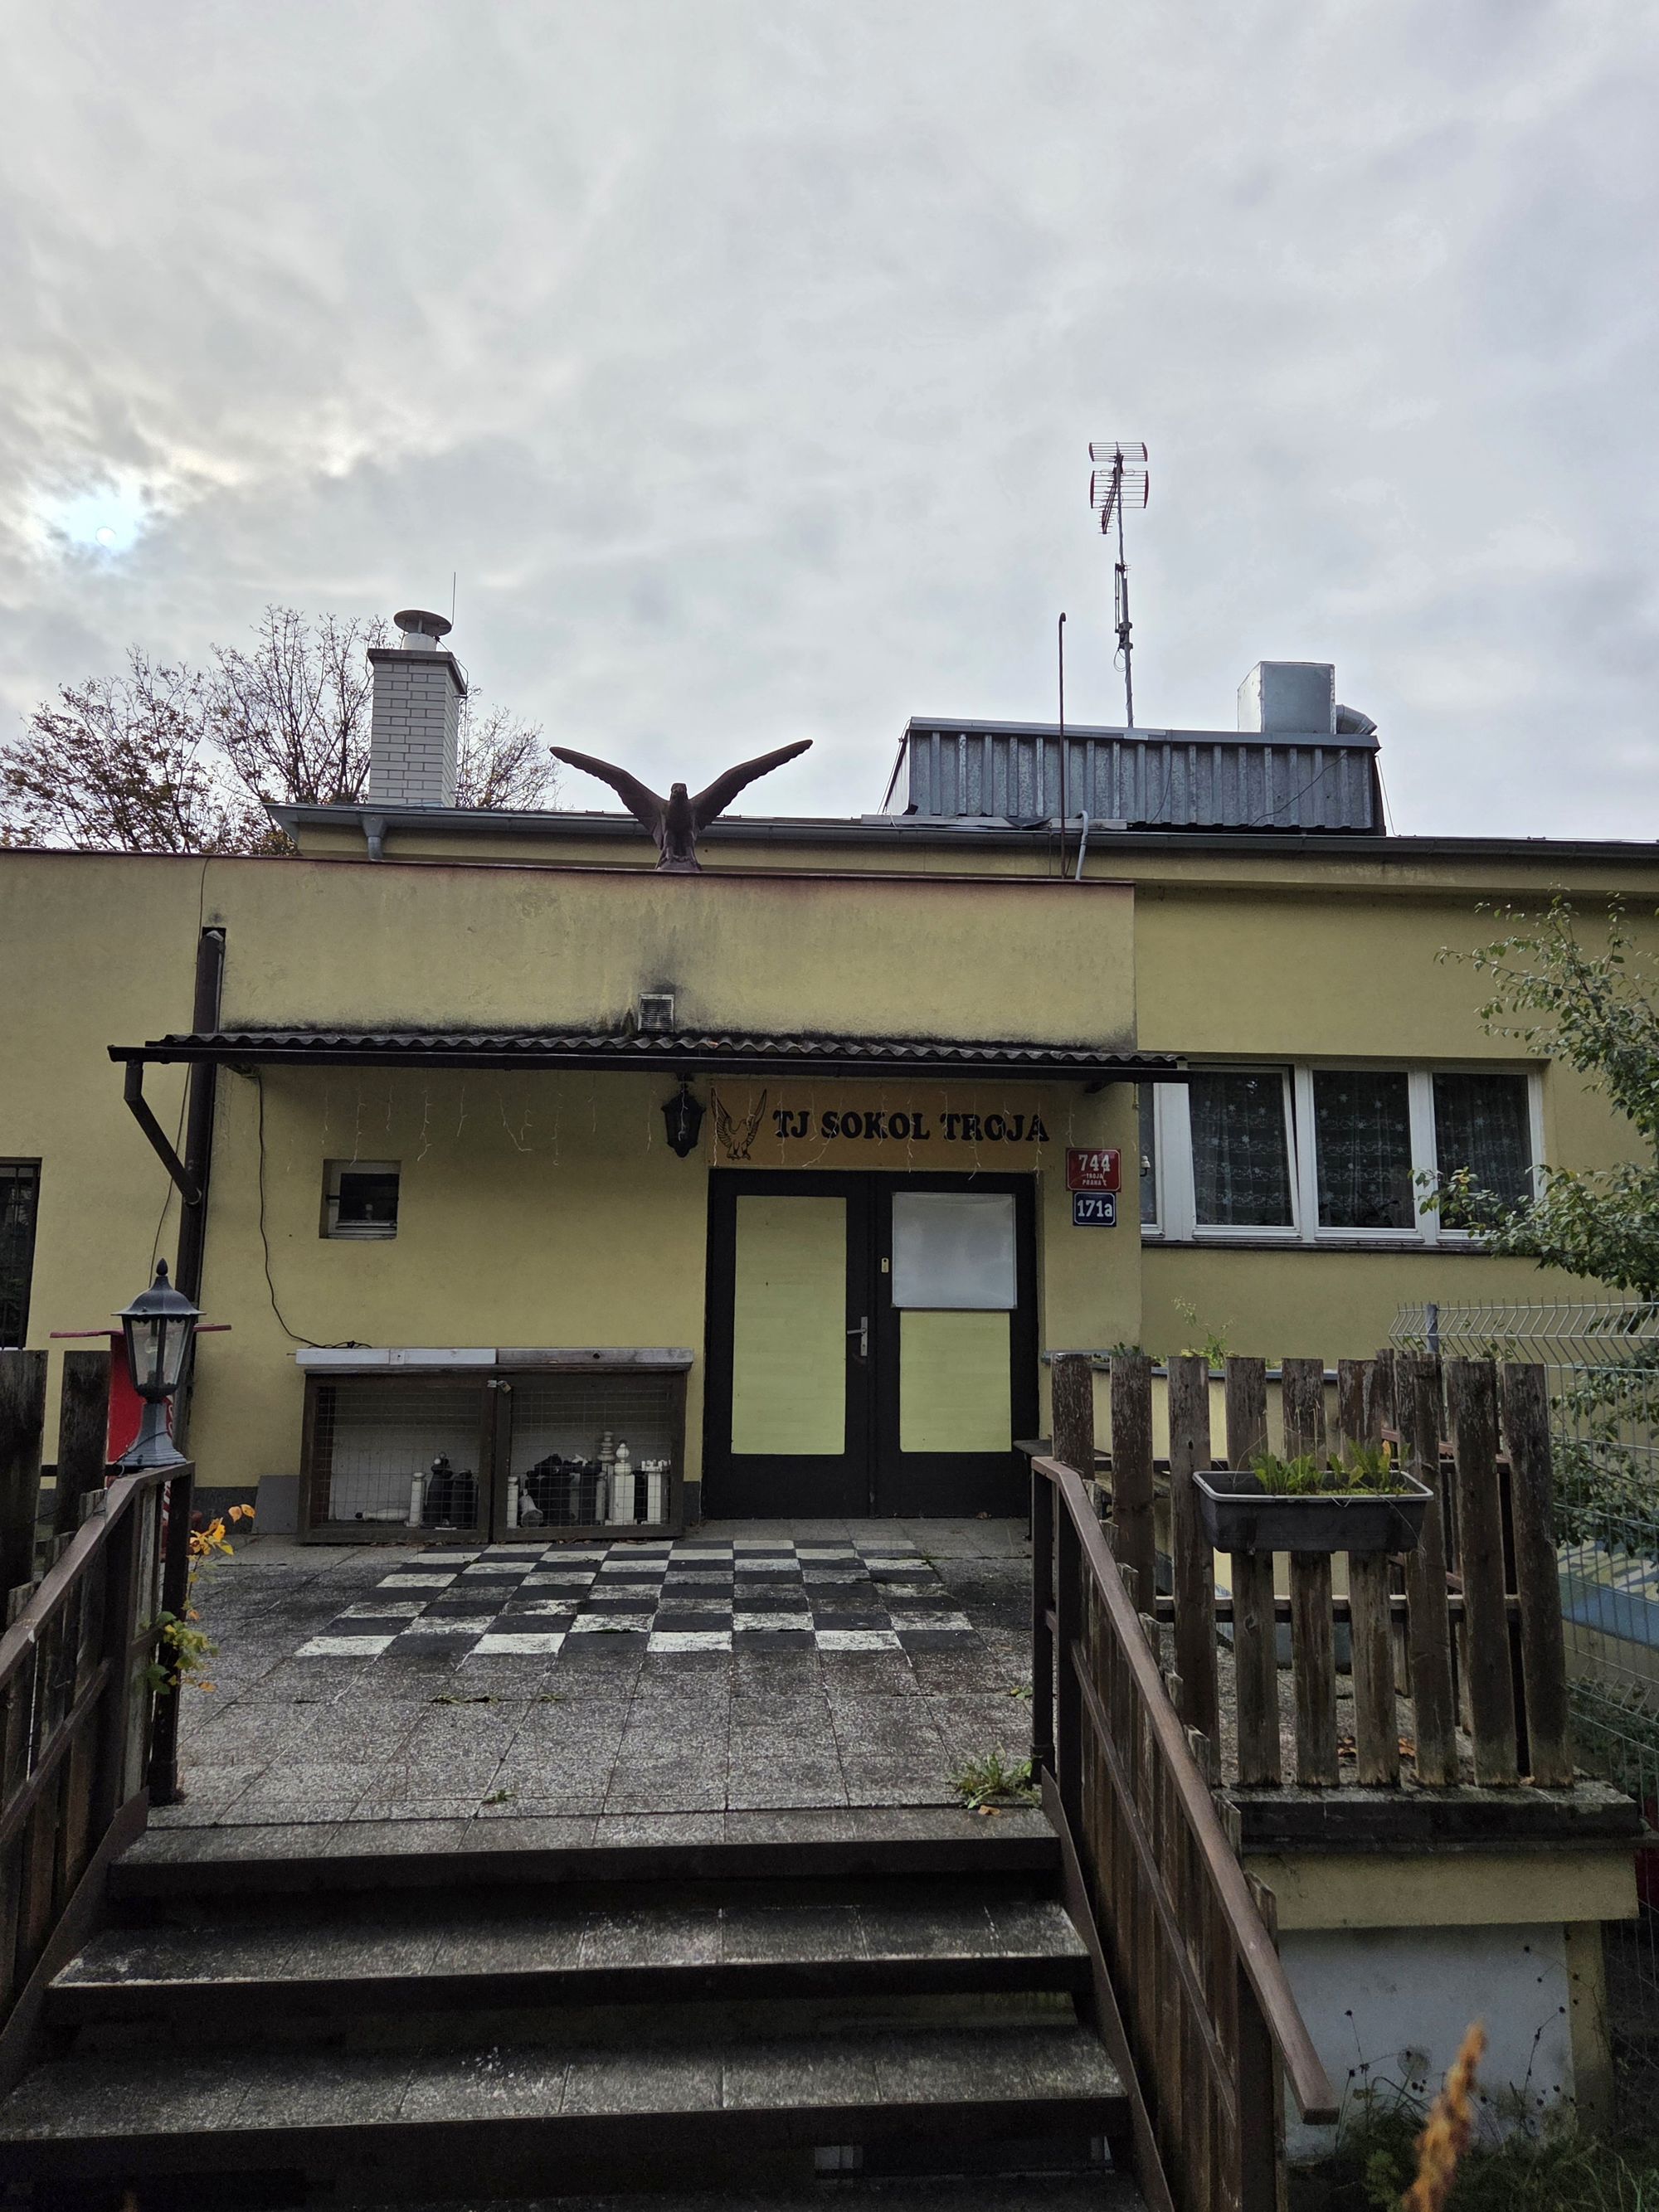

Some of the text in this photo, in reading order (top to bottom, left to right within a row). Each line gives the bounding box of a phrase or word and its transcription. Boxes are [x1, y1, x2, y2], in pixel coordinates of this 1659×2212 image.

[772, 1110, 1050, 1143] TJ SOKOL TROJA
[1078, 1154, 1111, 1172] 744
[1077, 1199, 1113, 1218] 171a
